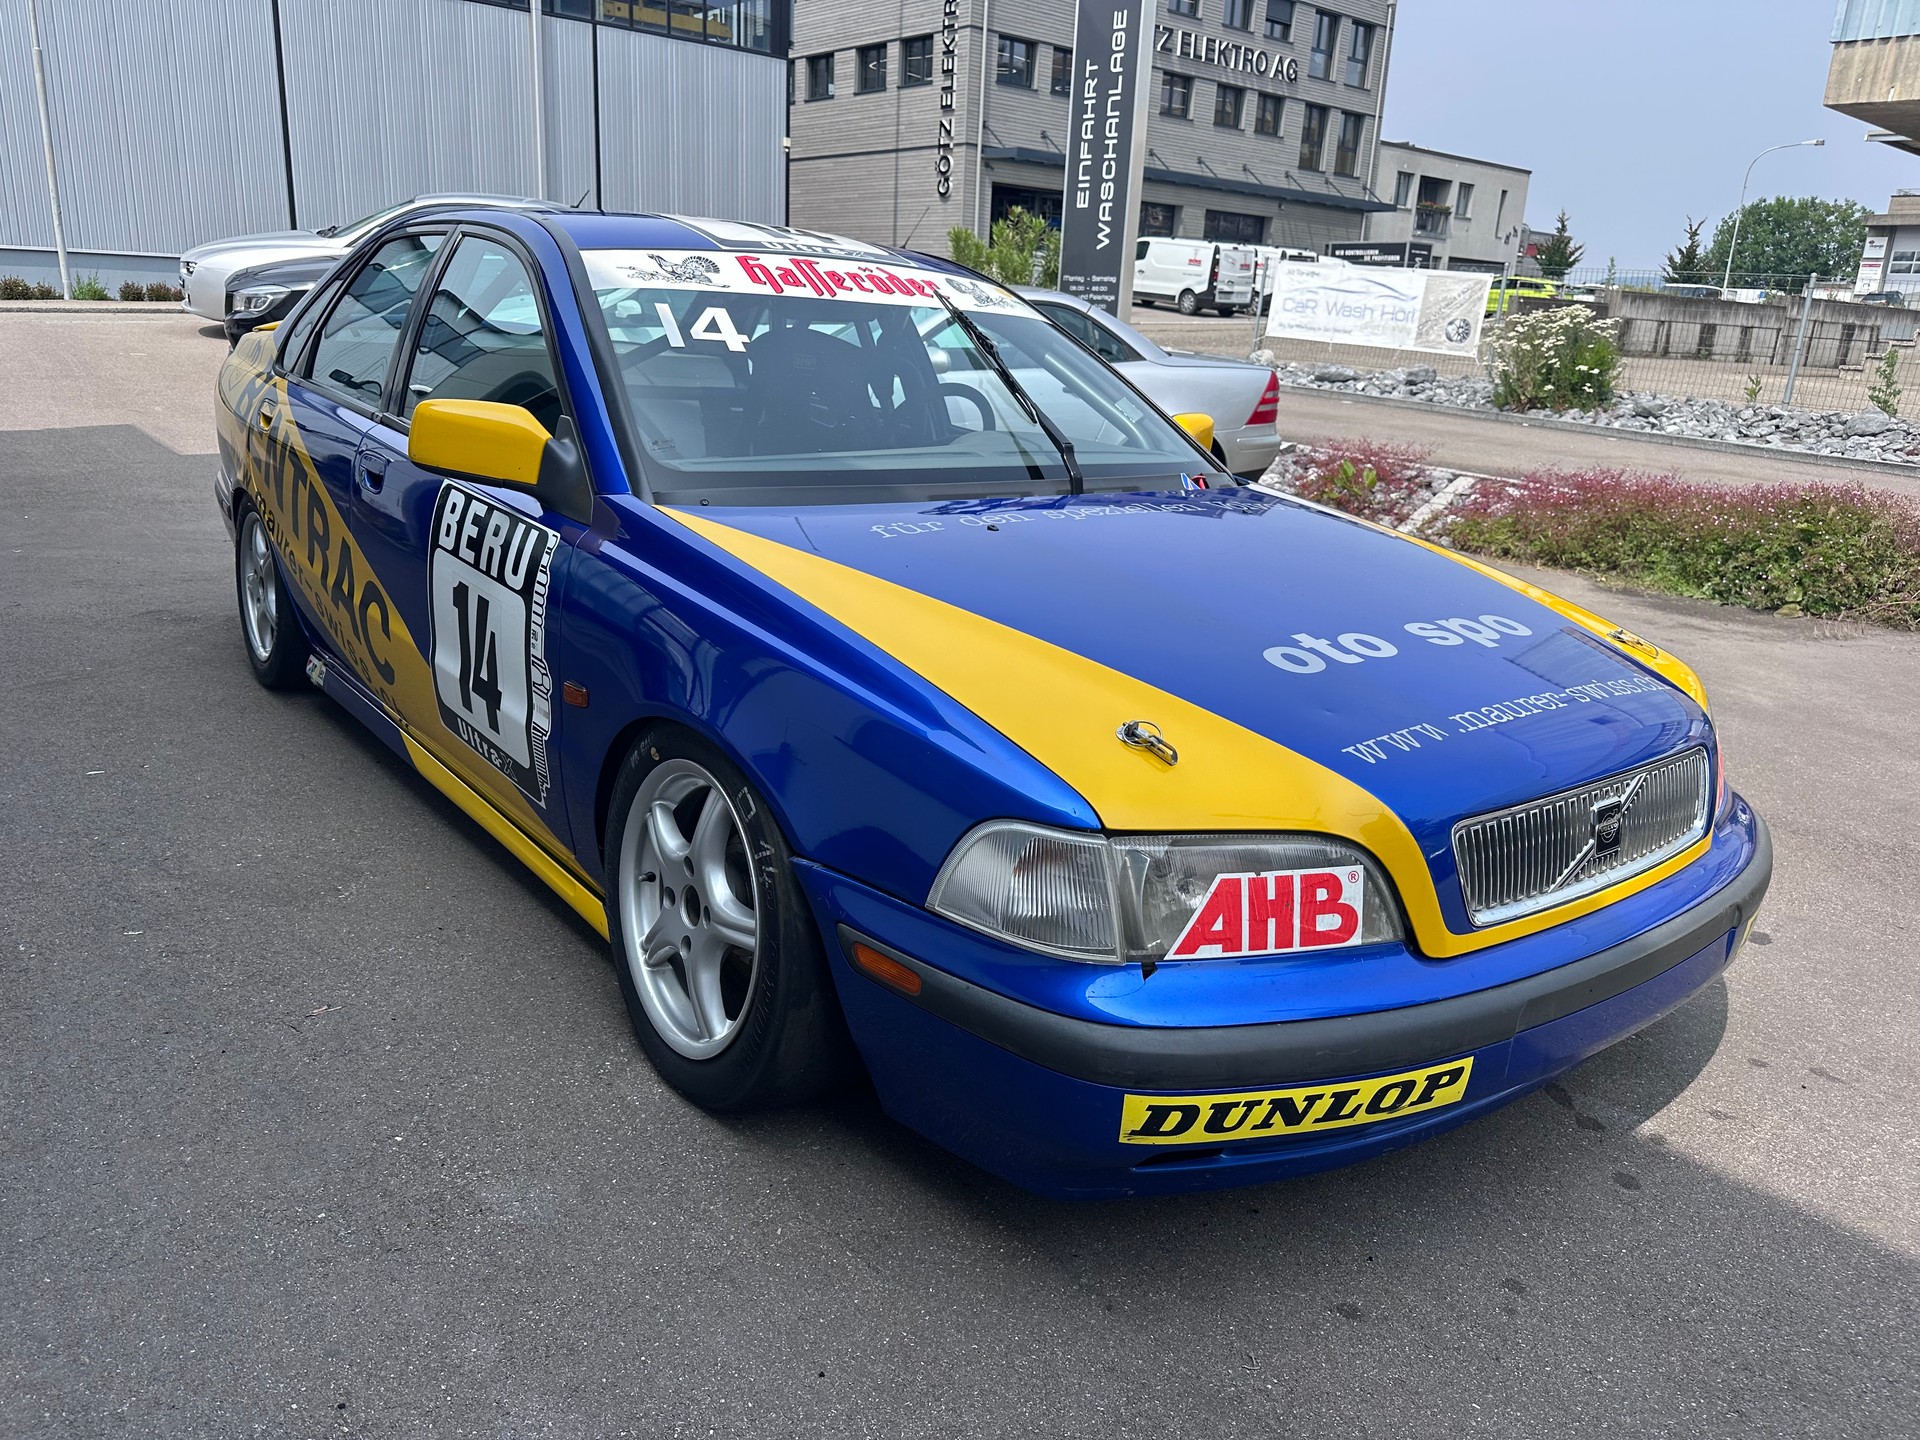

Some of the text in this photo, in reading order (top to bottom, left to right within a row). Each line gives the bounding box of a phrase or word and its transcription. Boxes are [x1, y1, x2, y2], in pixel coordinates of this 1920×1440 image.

[1177, 29, 1269, 77] ELEKTRO
[1269, 54, 1298, 84] AG
[935, 119, 955, 198] GÖTZ
[1076, 59, 1099, 209] EINFAHRT
[1096, 9, 1128, 250] WASCHANLAGE
[654, 302, 751, 353] 14
[1326, 300, 1374, 320] Wash
[438, 488, 540, 591] BERU
[870, 520, 946, 539] für
[959, 511, 1036, 527] den
[452, 580, 503, 737] 14
[1262, 614, 1533, 674] oto spo
[1128, 1065, 1466, 1138] DUNLOP
